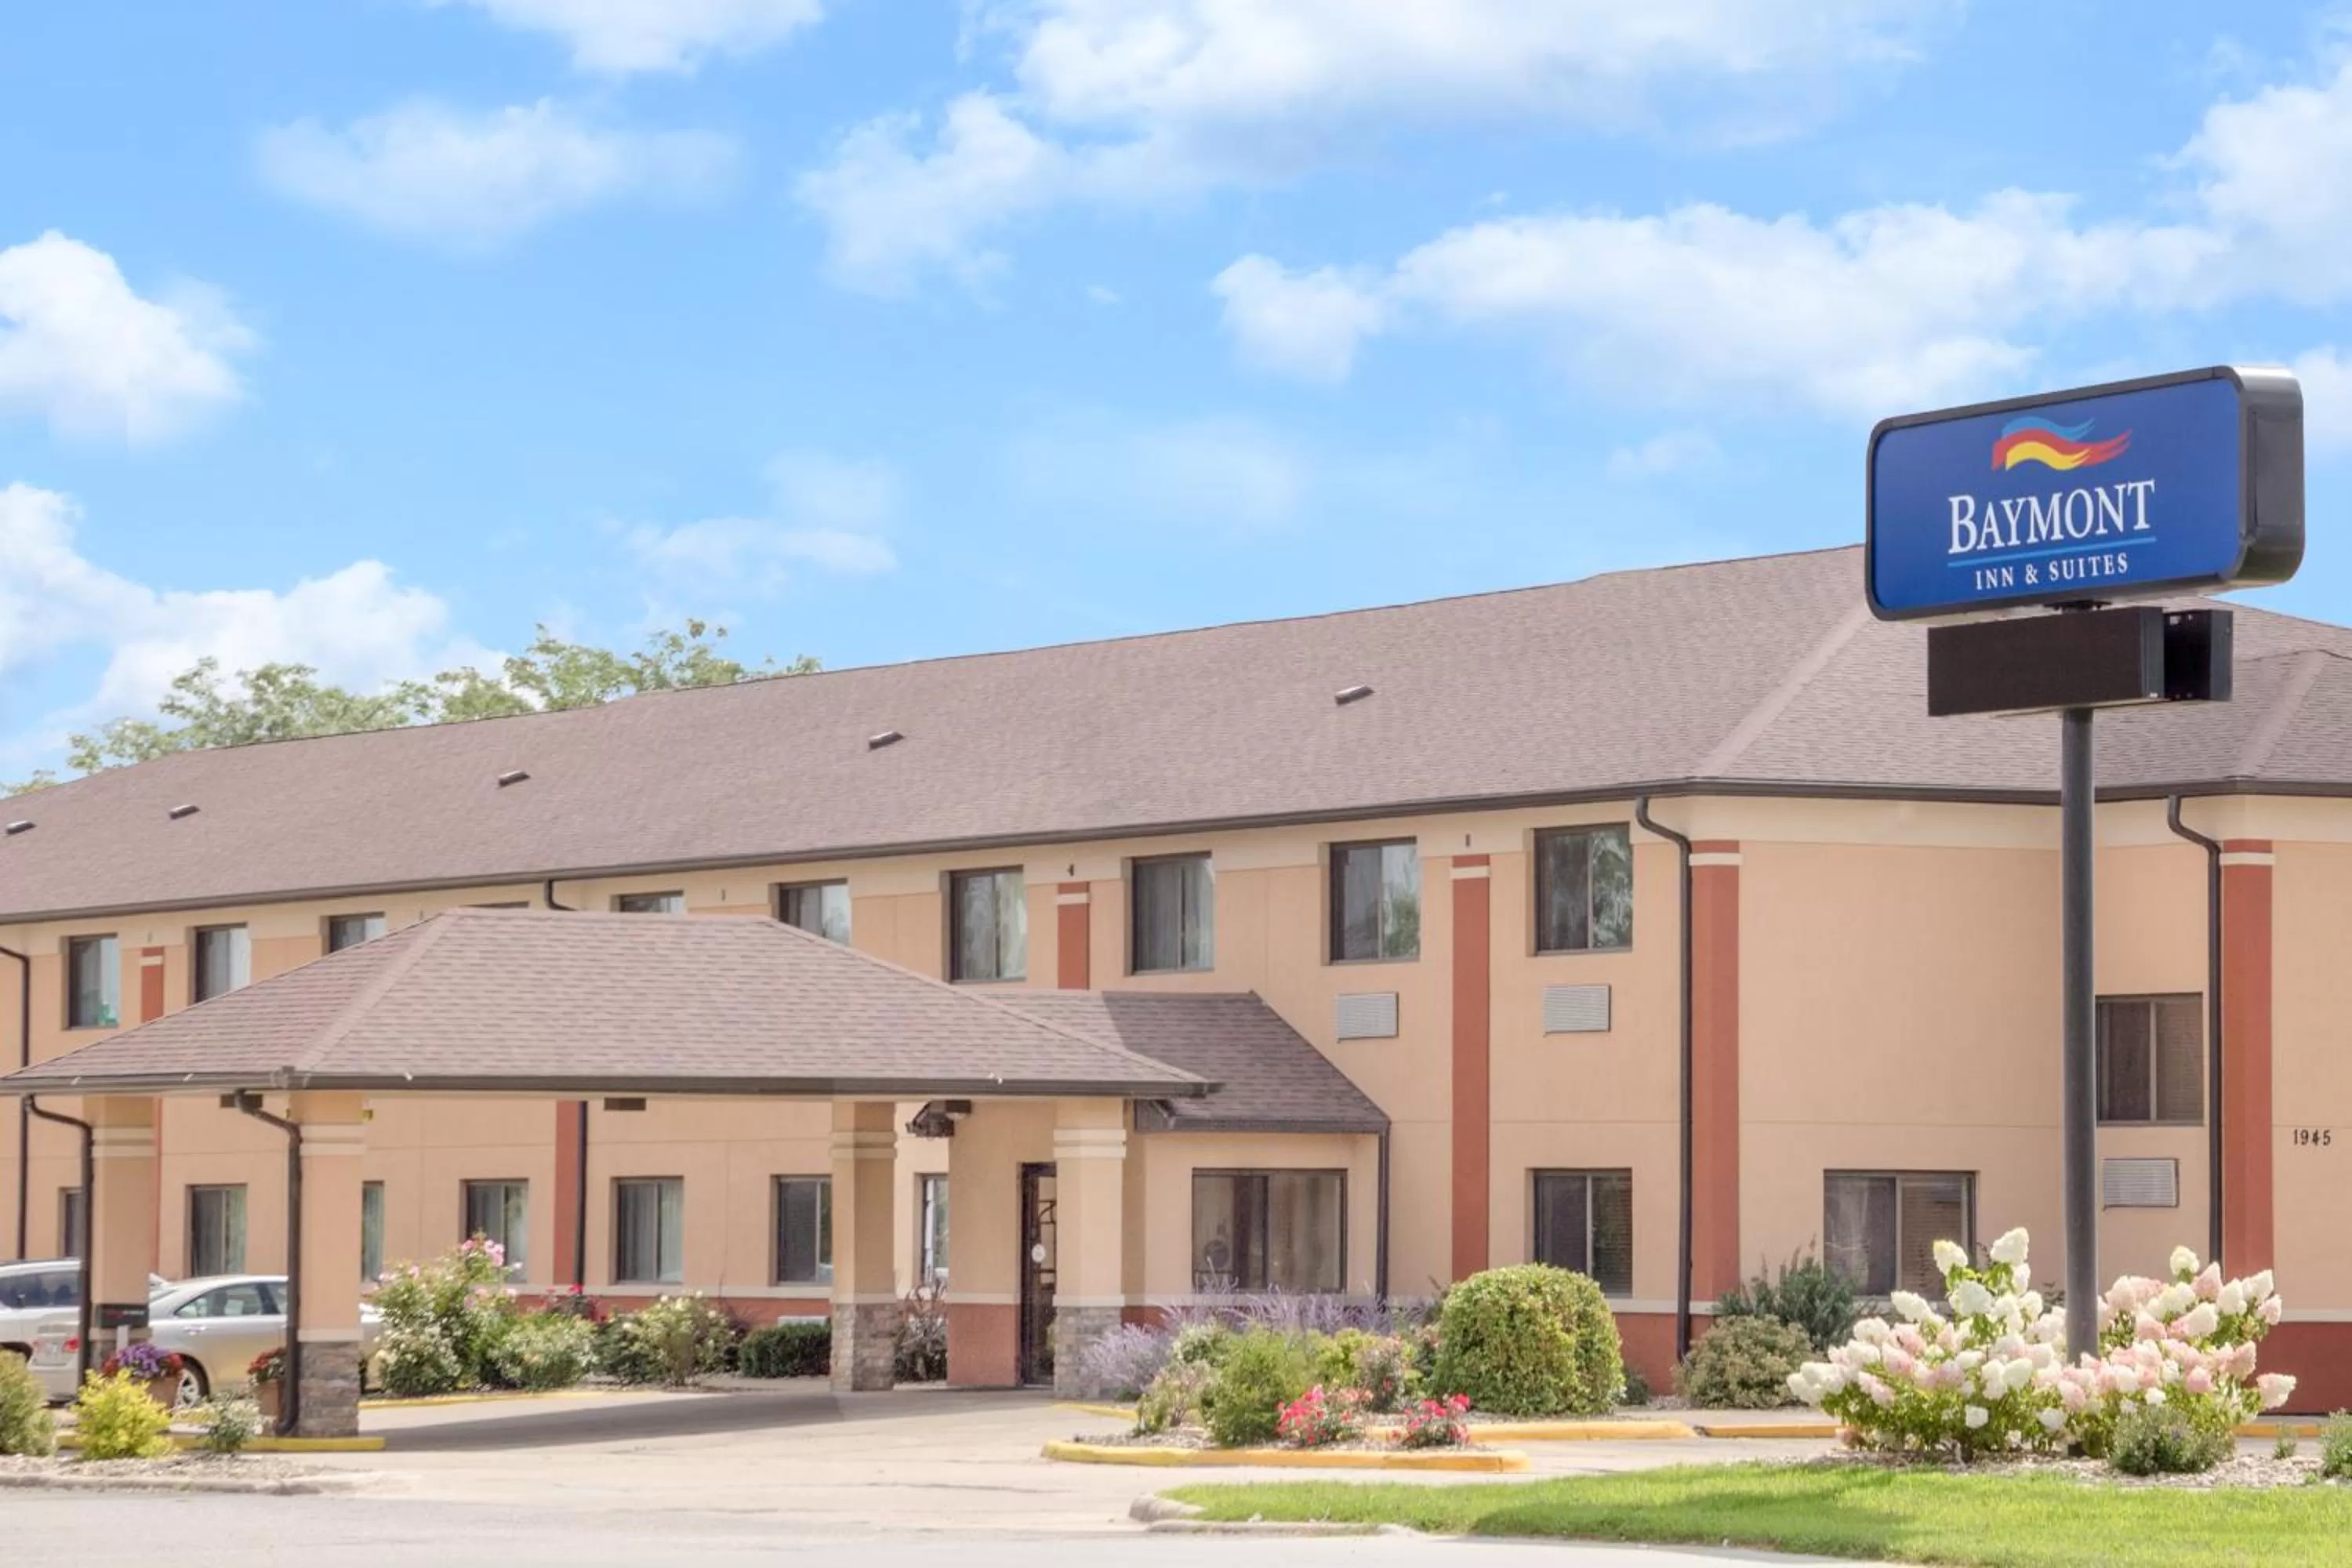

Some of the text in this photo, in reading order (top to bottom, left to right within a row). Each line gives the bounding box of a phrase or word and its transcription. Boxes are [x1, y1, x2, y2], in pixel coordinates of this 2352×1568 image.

[1947, 478, 2156, 555] BAYMONT
[1975, 552, 2129, 590] INN & SUITES
[2293, 1128, 2332, 1147] 1945
